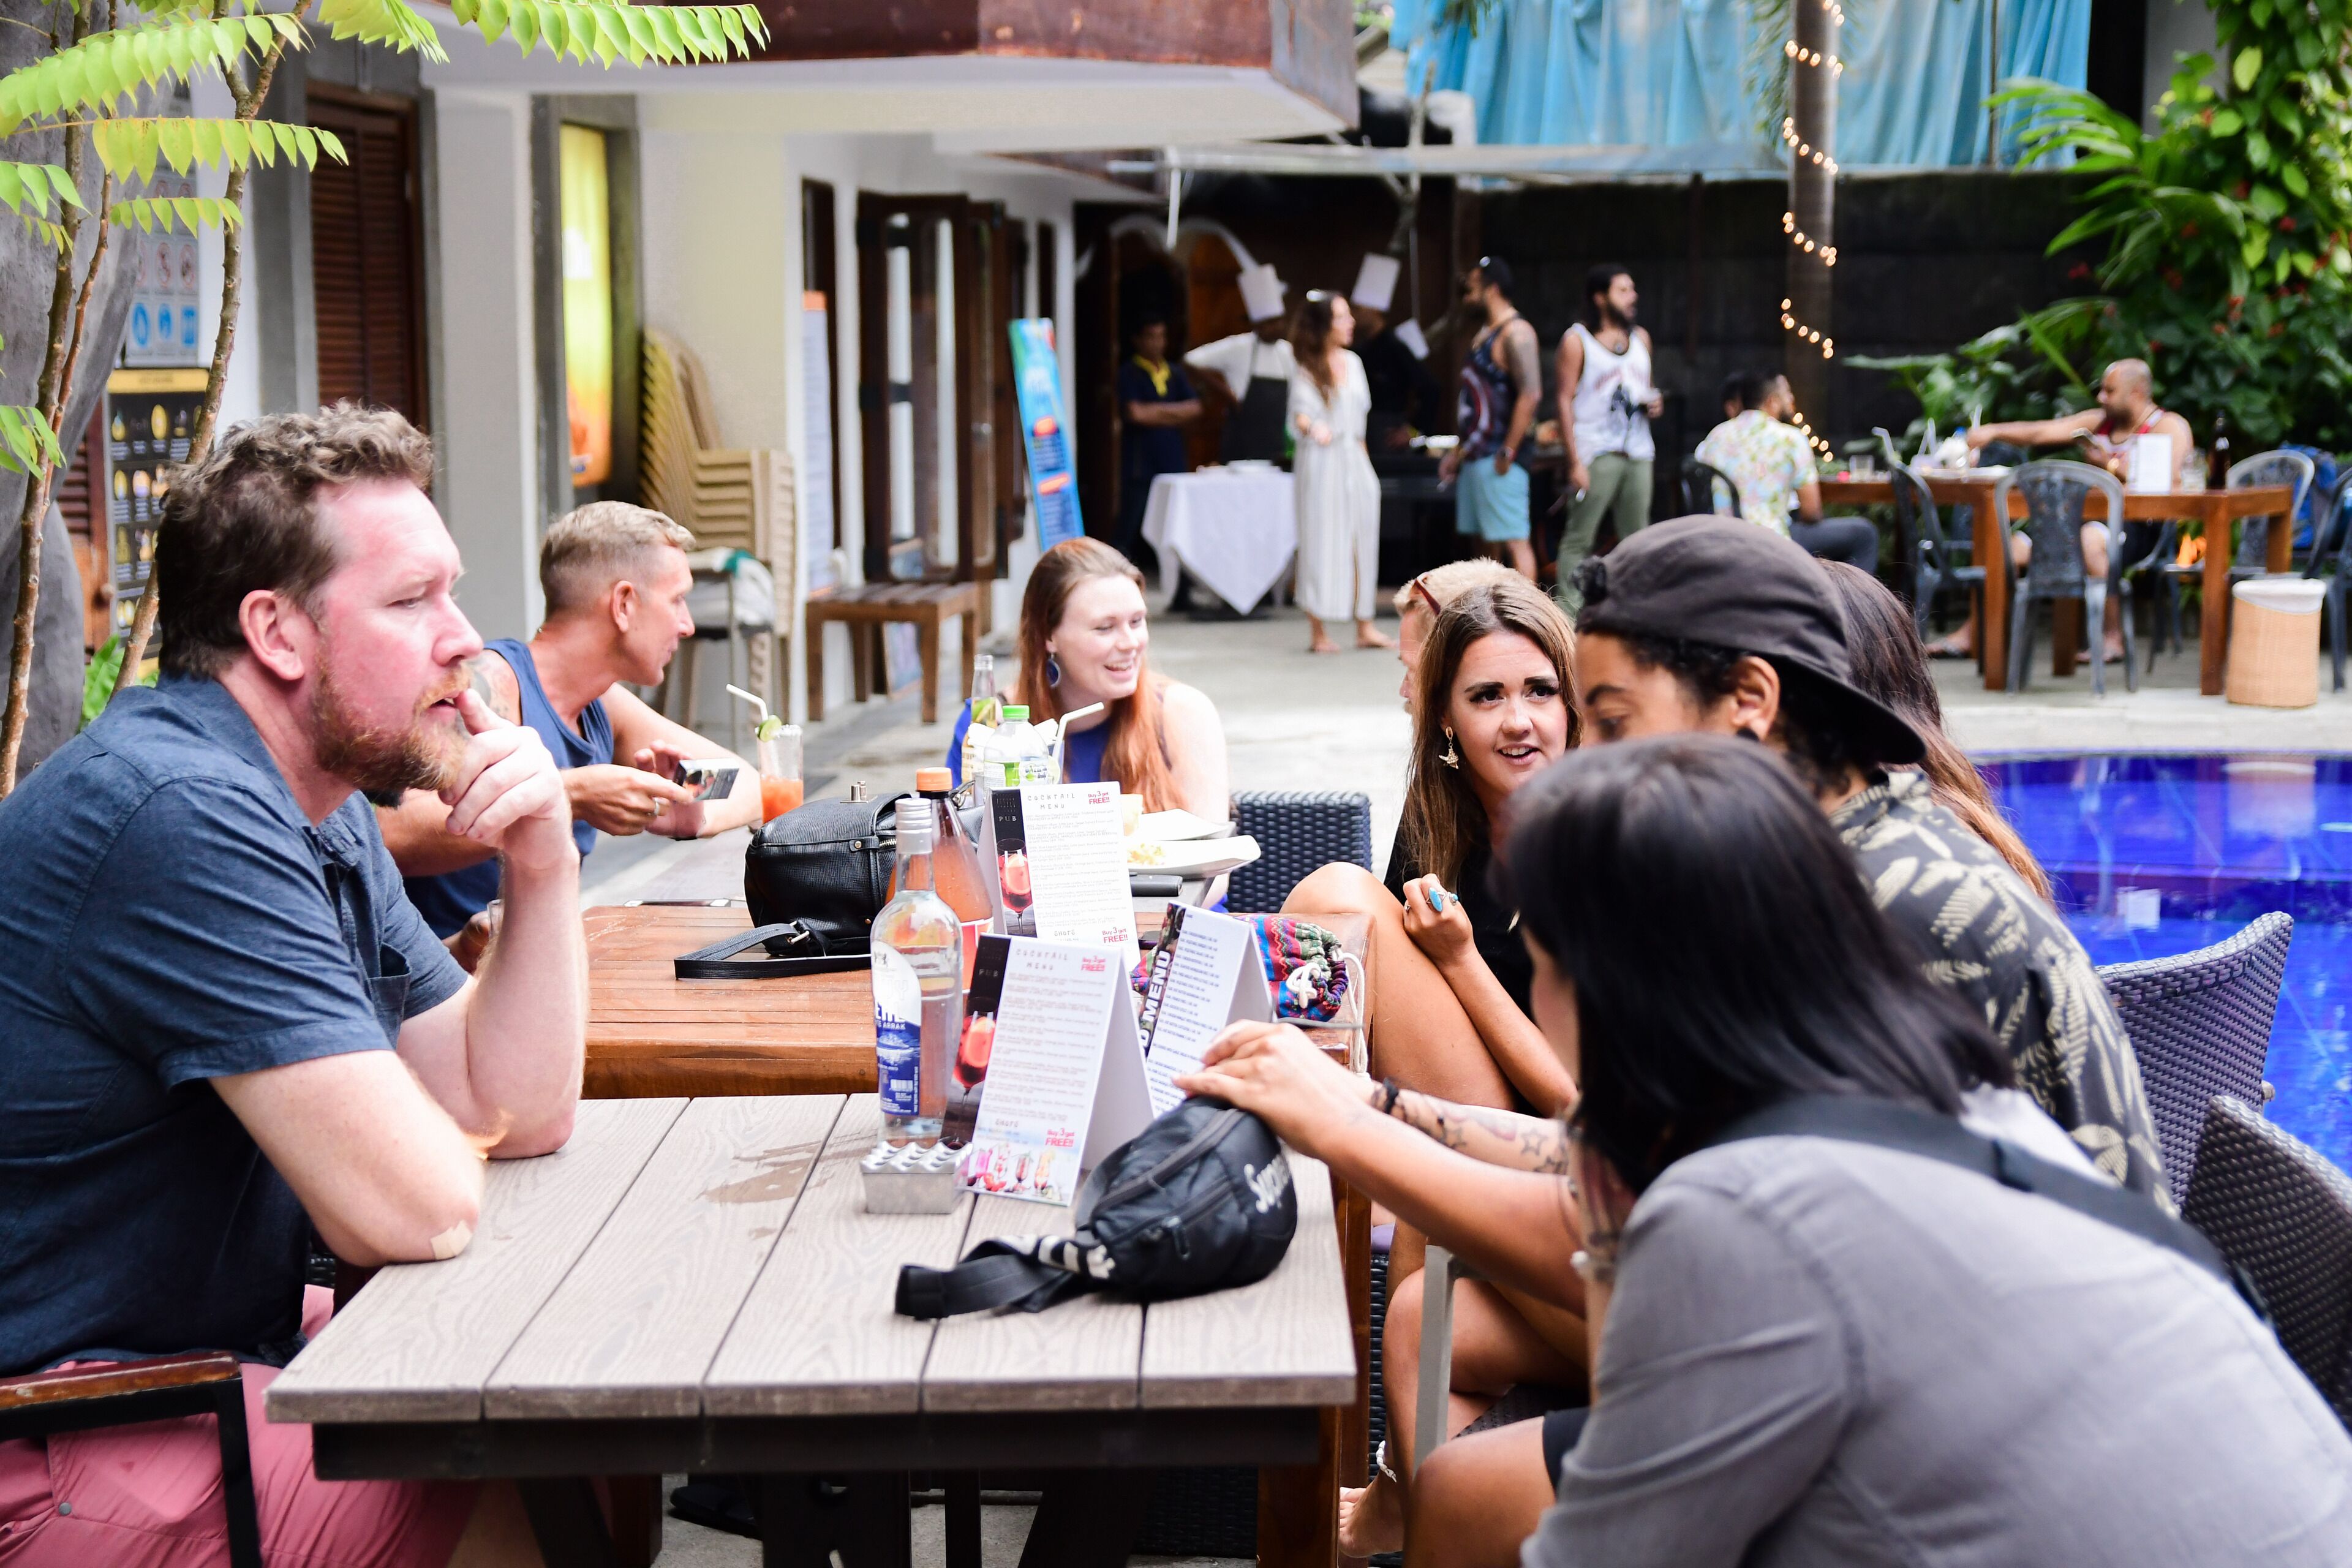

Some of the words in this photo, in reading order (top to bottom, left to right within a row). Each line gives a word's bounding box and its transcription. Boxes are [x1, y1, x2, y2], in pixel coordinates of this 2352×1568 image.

[1103, 934, 1128, 943] FREE!!
[1016, 948, 1068, 961] COCKTAIL
[1142, 950, 1171, 1022] MENU
[1047, 1129, 1058, 1137] Buy
[1060, 1127, 1065, 1136] 3
